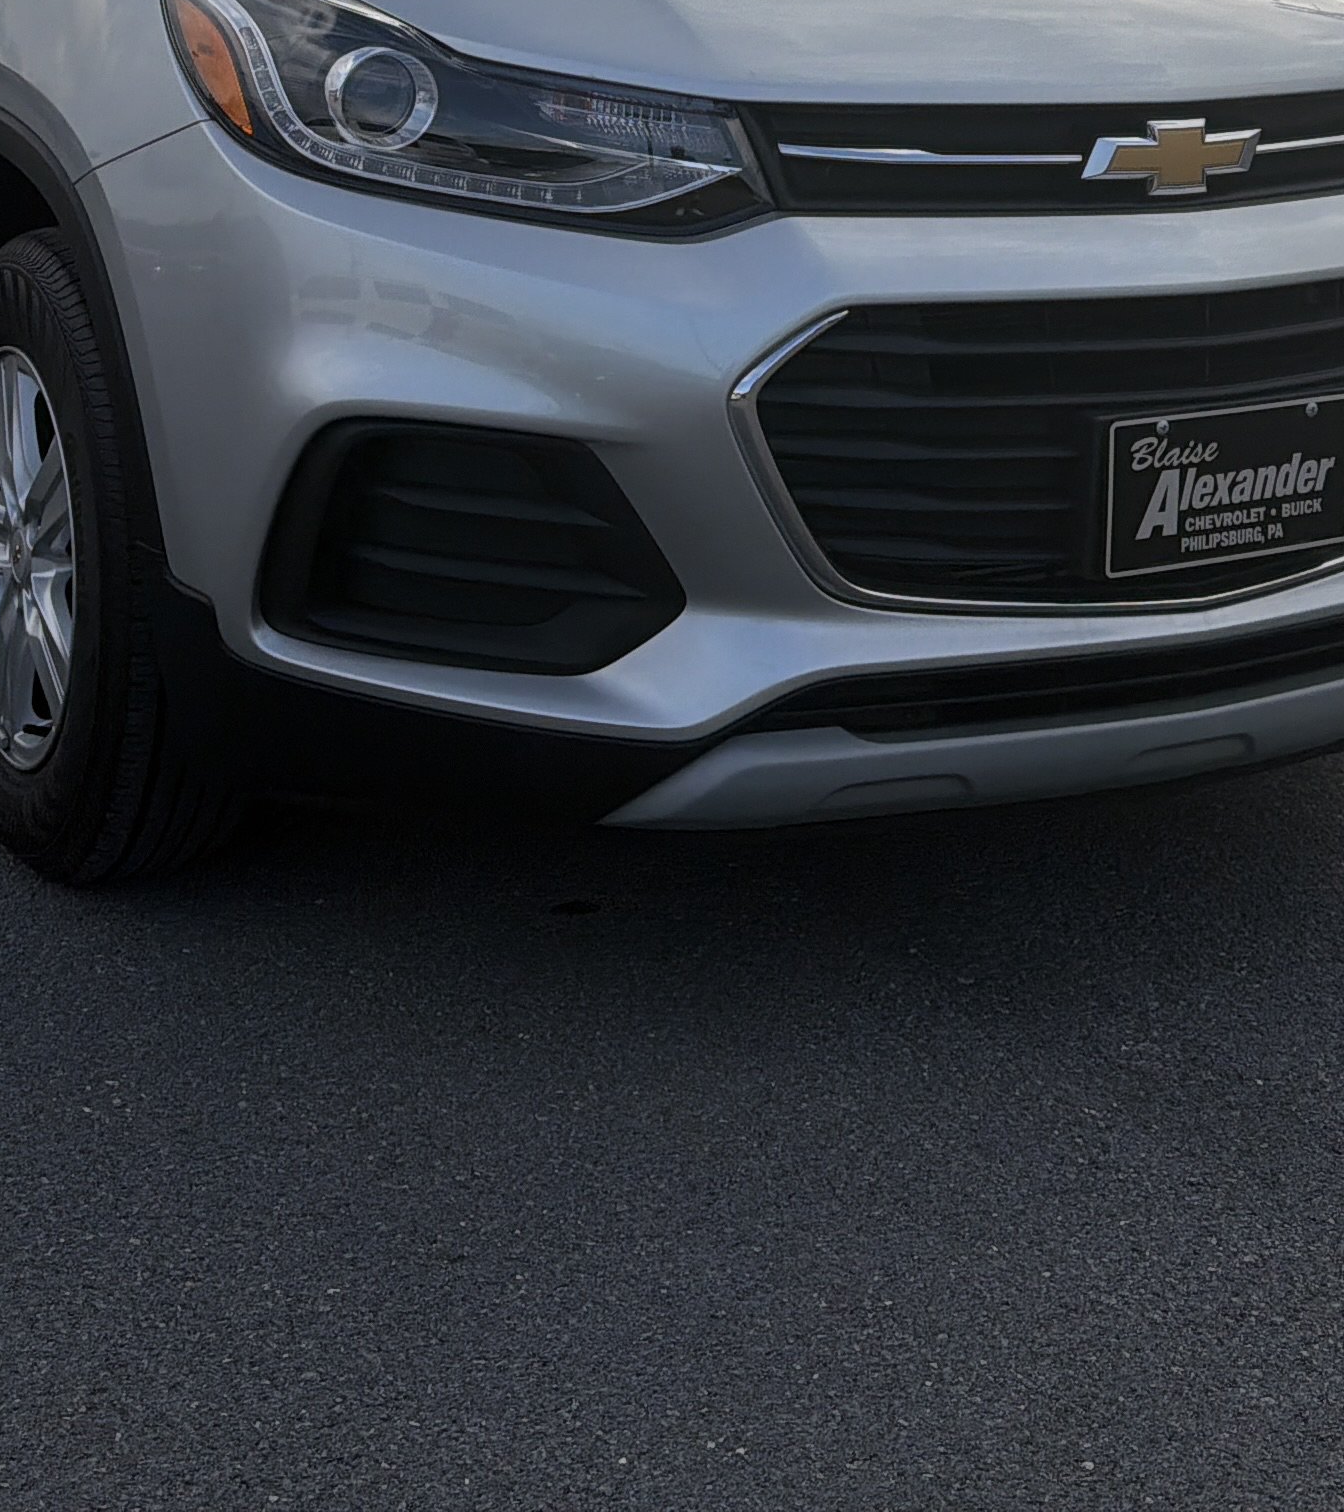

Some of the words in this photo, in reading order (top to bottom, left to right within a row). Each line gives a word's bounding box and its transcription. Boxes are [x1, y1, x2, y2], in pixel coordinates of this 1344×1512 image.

[1130, 436, 1219, 472] Blaise
[1135, 452, 1336, 541] Alexander
[1185, 506, 1266, 532] CHEVROLET
[1281, 498, 1323, 518] BUICK
[1181, 528, 1265, 553] PHILIPSBURG,
[1267, 523, 1284, 540] PA
